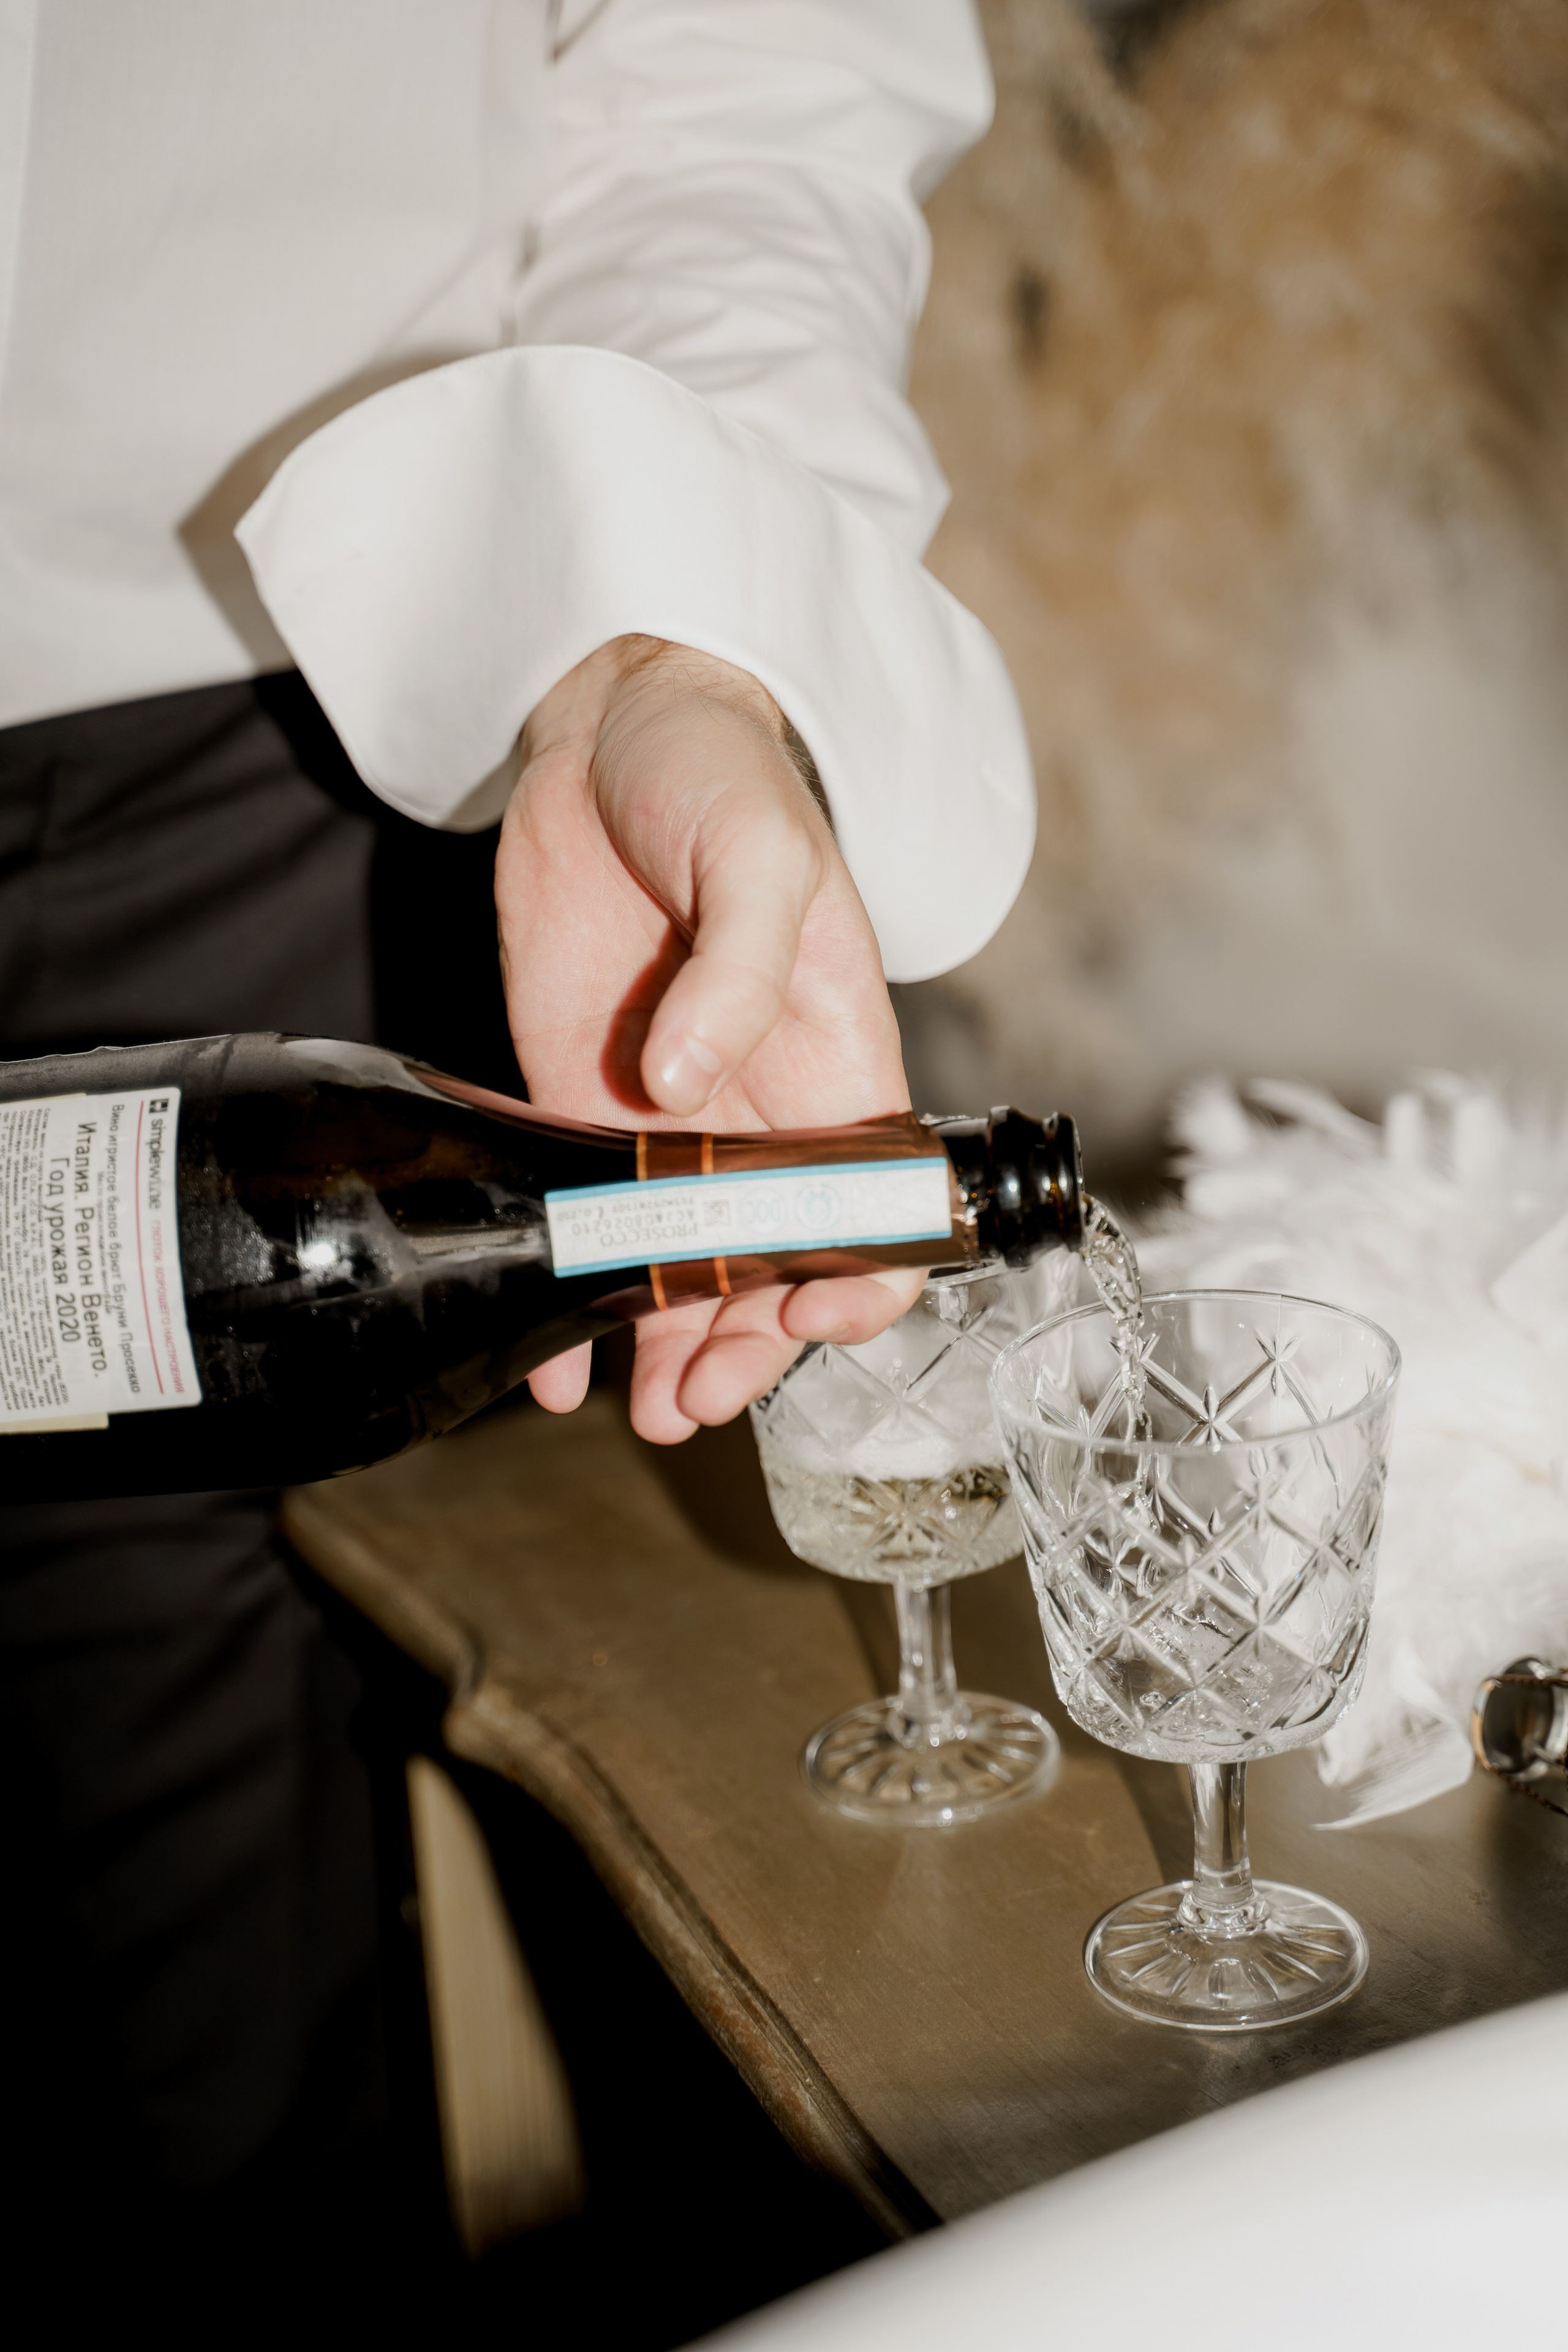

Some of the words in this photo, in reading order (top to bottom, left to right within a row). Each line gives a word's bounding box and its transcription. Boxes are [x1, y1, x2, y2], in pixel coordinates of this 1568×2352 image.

[110, 1104, 125, 1132] Вино
[47, 1157, 70, 1196] Год
[75, 1121, 98, 1200] Италия.
[106, 1135, 118, 1191] игристое
[146, 1118, 168, 1210] simplewine
[44, 1202, 69, 1284] урожая
[108, 1196, 120, 1238] белое
[152, 1220, 164, 1262] ГЛОТОК
[599, 1222, 699, 1248] PROSECCO
[74, 1207, 95, 1286] Регион
[107, 1242, 123, 1278] брют
[56, 1293, 80, 1342] 2020
[110, 1284, 128, 1327] Бруни
[155, 1267, 172, 1324] ХОРОШЕГО
[81, 1294, 108, 1378] Венето.
[119, 1332, 141, 1393] Просекко
[163, 1327, 184, 1393] НАСТРОЕНИЯ
